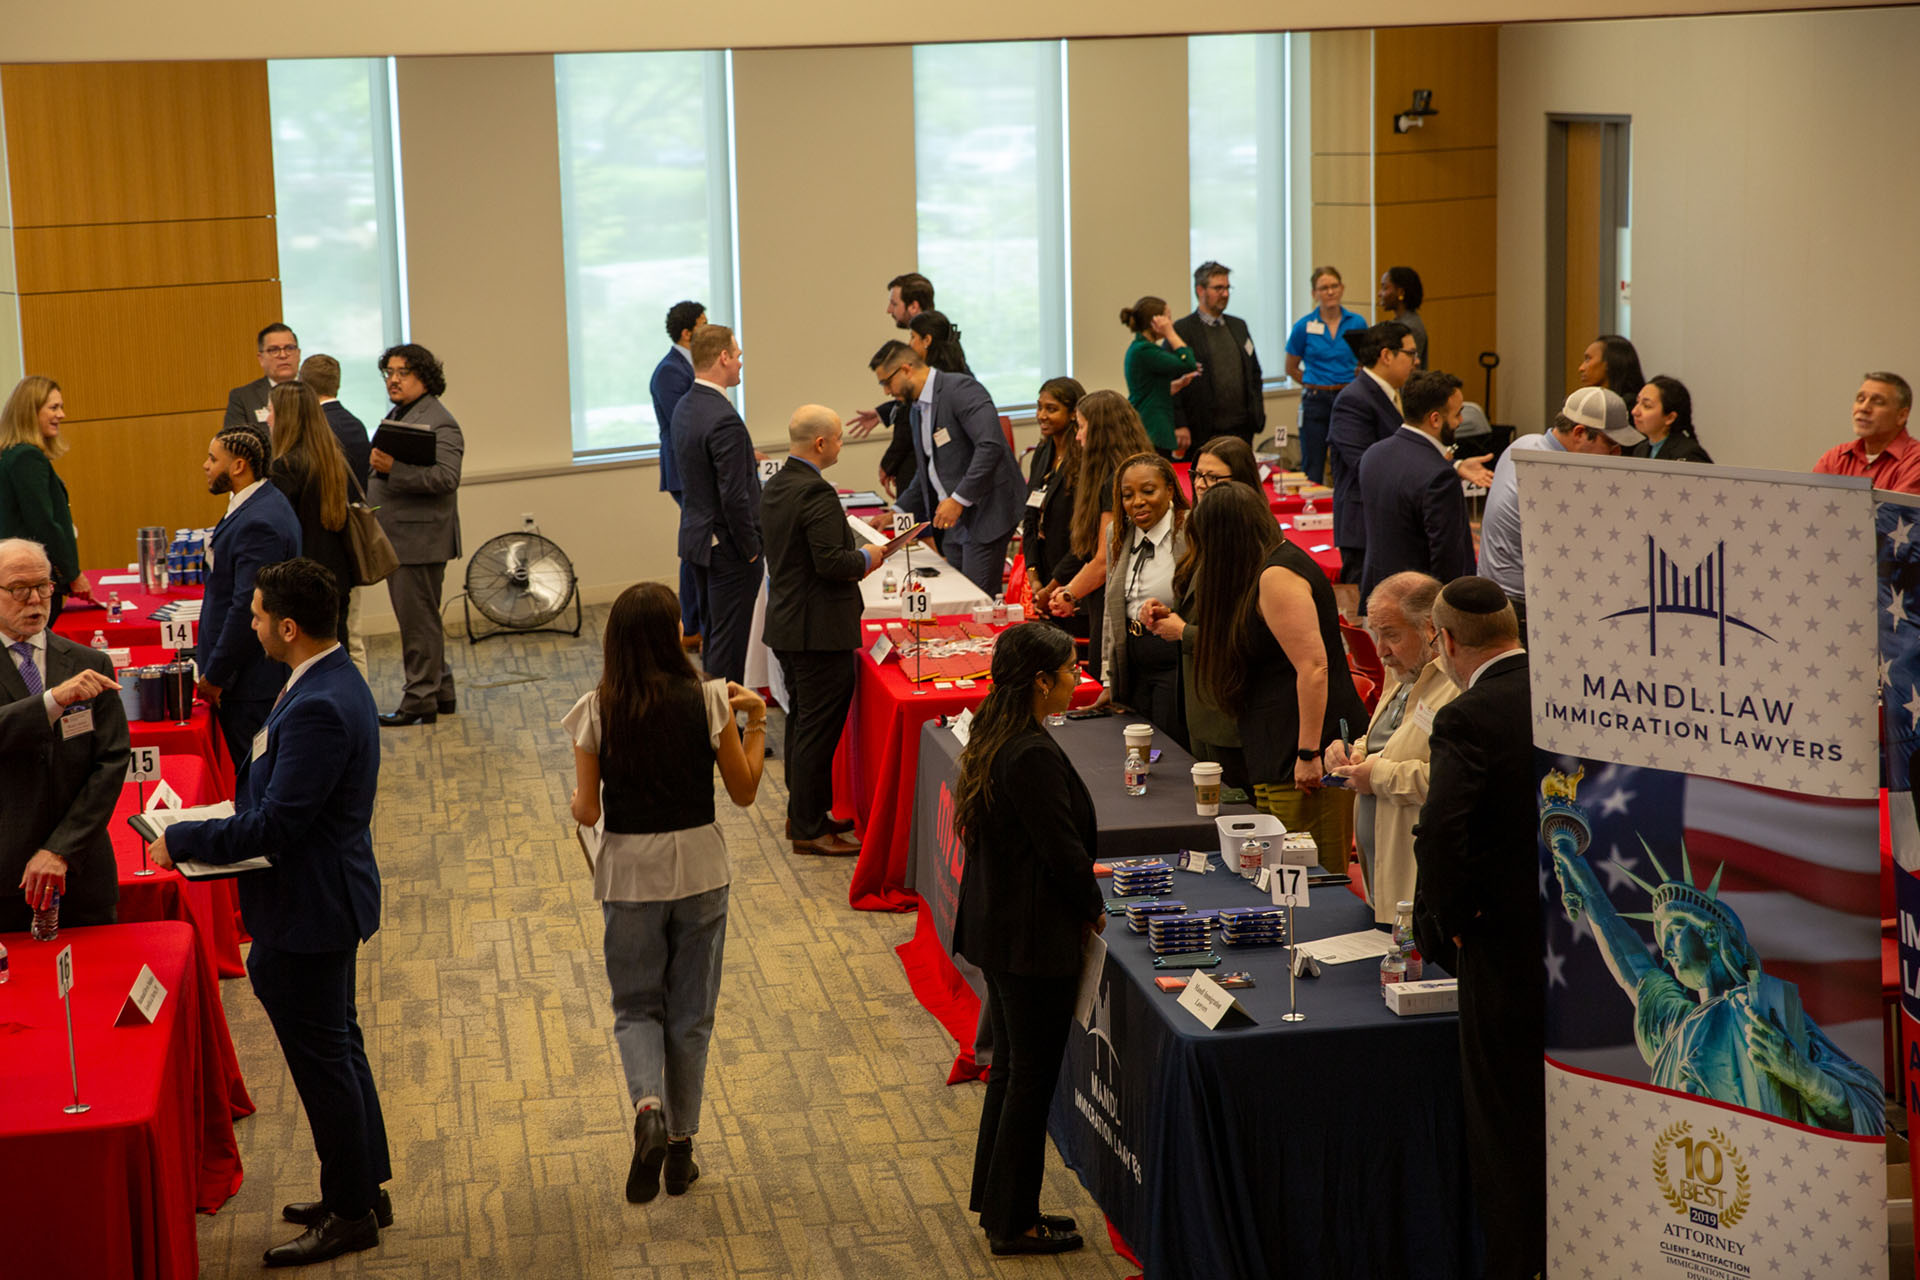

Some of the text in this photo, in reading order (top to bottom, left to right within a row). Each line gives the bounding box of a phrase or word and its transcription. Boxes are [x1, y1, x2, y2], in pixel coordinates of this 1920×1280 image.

[765, 462, 779, 475] 21
[897, 516, 911, 531] 20
[907, 594, 927, 613] 19
[166, 624, 187, 641] 14
[1583, 673, 1794, 726] MANDL.LAW
[1545, 702, 1843, 762] IMMIGRATION LAWYERS
[131, 750, 153, 773] 15
[1276, 868, 1300, 894] 17
[59, 951, 70, 985] 16
[1091, 1071, 1121, 1127] MANDL
[1675, 1136, 1723, 1185] 10
[1680, 1179, 1727, 1210] BEST
[1691, 1209, 1718, 1227] 2019
[1664, 1222, 1746, 1257] ATTORNEY
[1660, 1241, 1750, 1274] CLIENT SATISFACTION
[1666, 1256, 1725, 1279] IMMIGRATION
